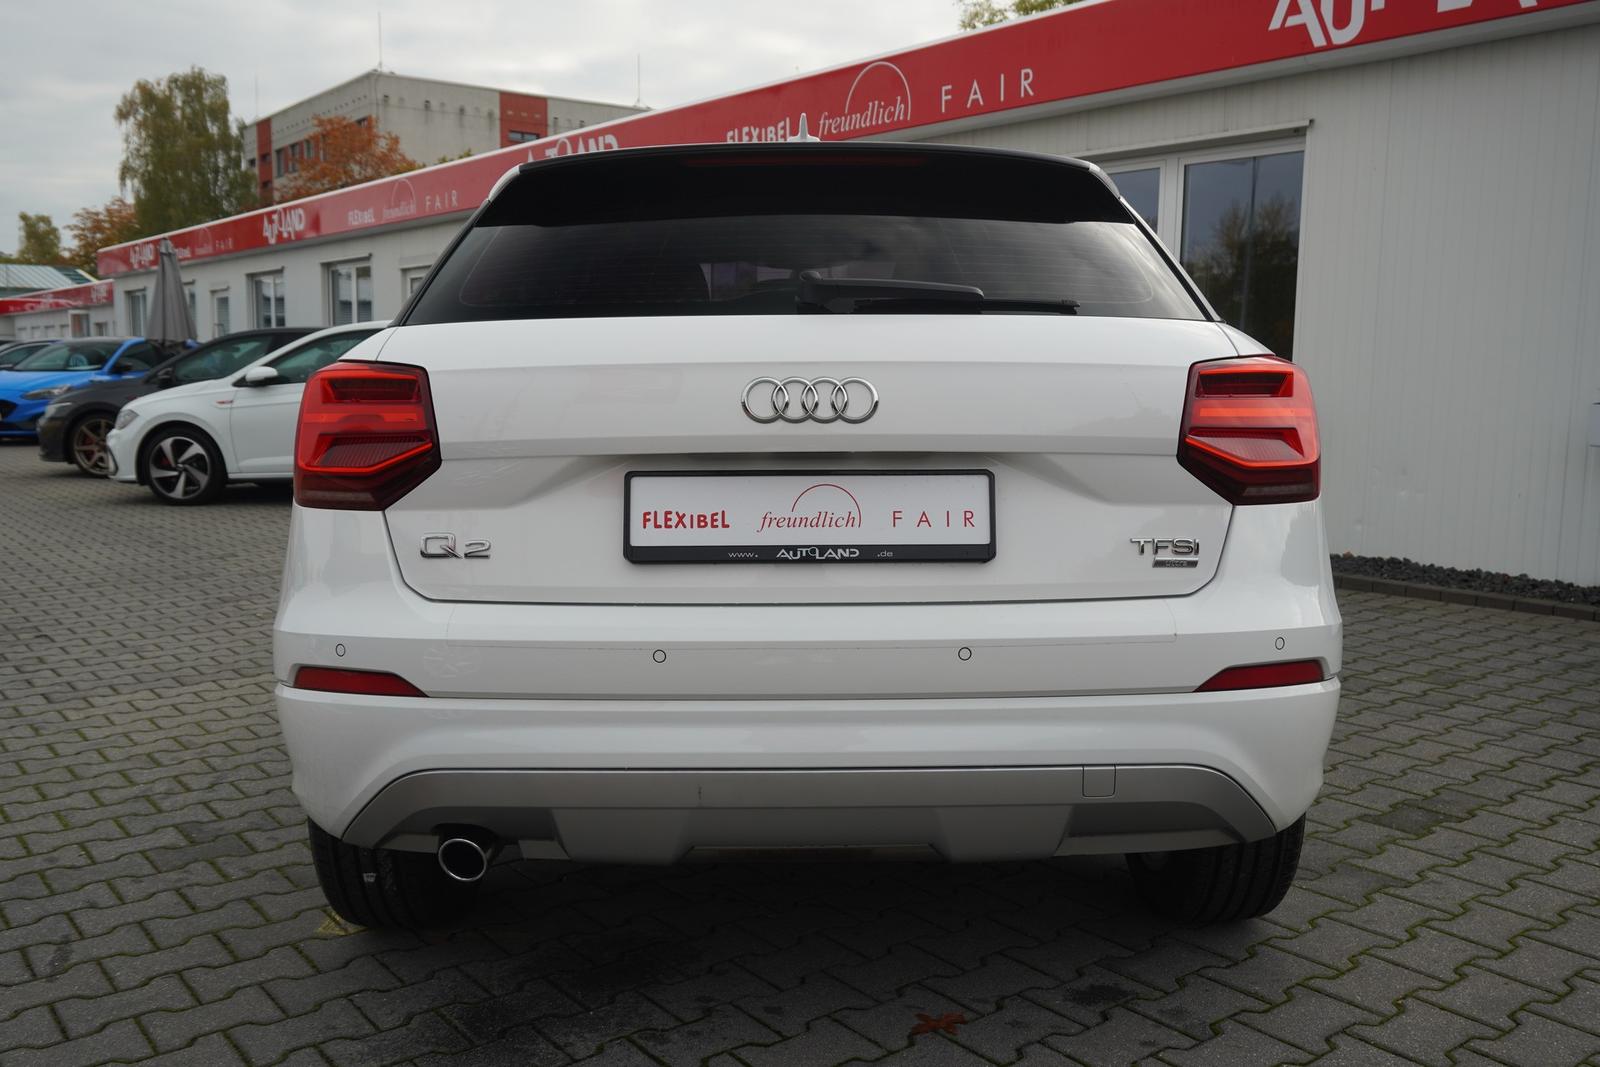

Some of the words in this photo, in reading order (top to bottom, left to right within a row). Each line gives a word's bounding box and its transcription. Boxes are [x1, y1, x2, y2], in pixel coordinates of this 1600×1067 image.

[818, 96, 905, 137] freundlich
[941, 68, 1035, 112] FAIR
[425, 190, 459, 211] FAIR
[643, 510, 730, 529] FLEXIBEL
[756, 510, 856, 533] freundlich
[892, 510, 975, 528] FAIR
[776, 547, 860, 560] AUTOLAND
[1130, 538, 1200, 555] TFSI
